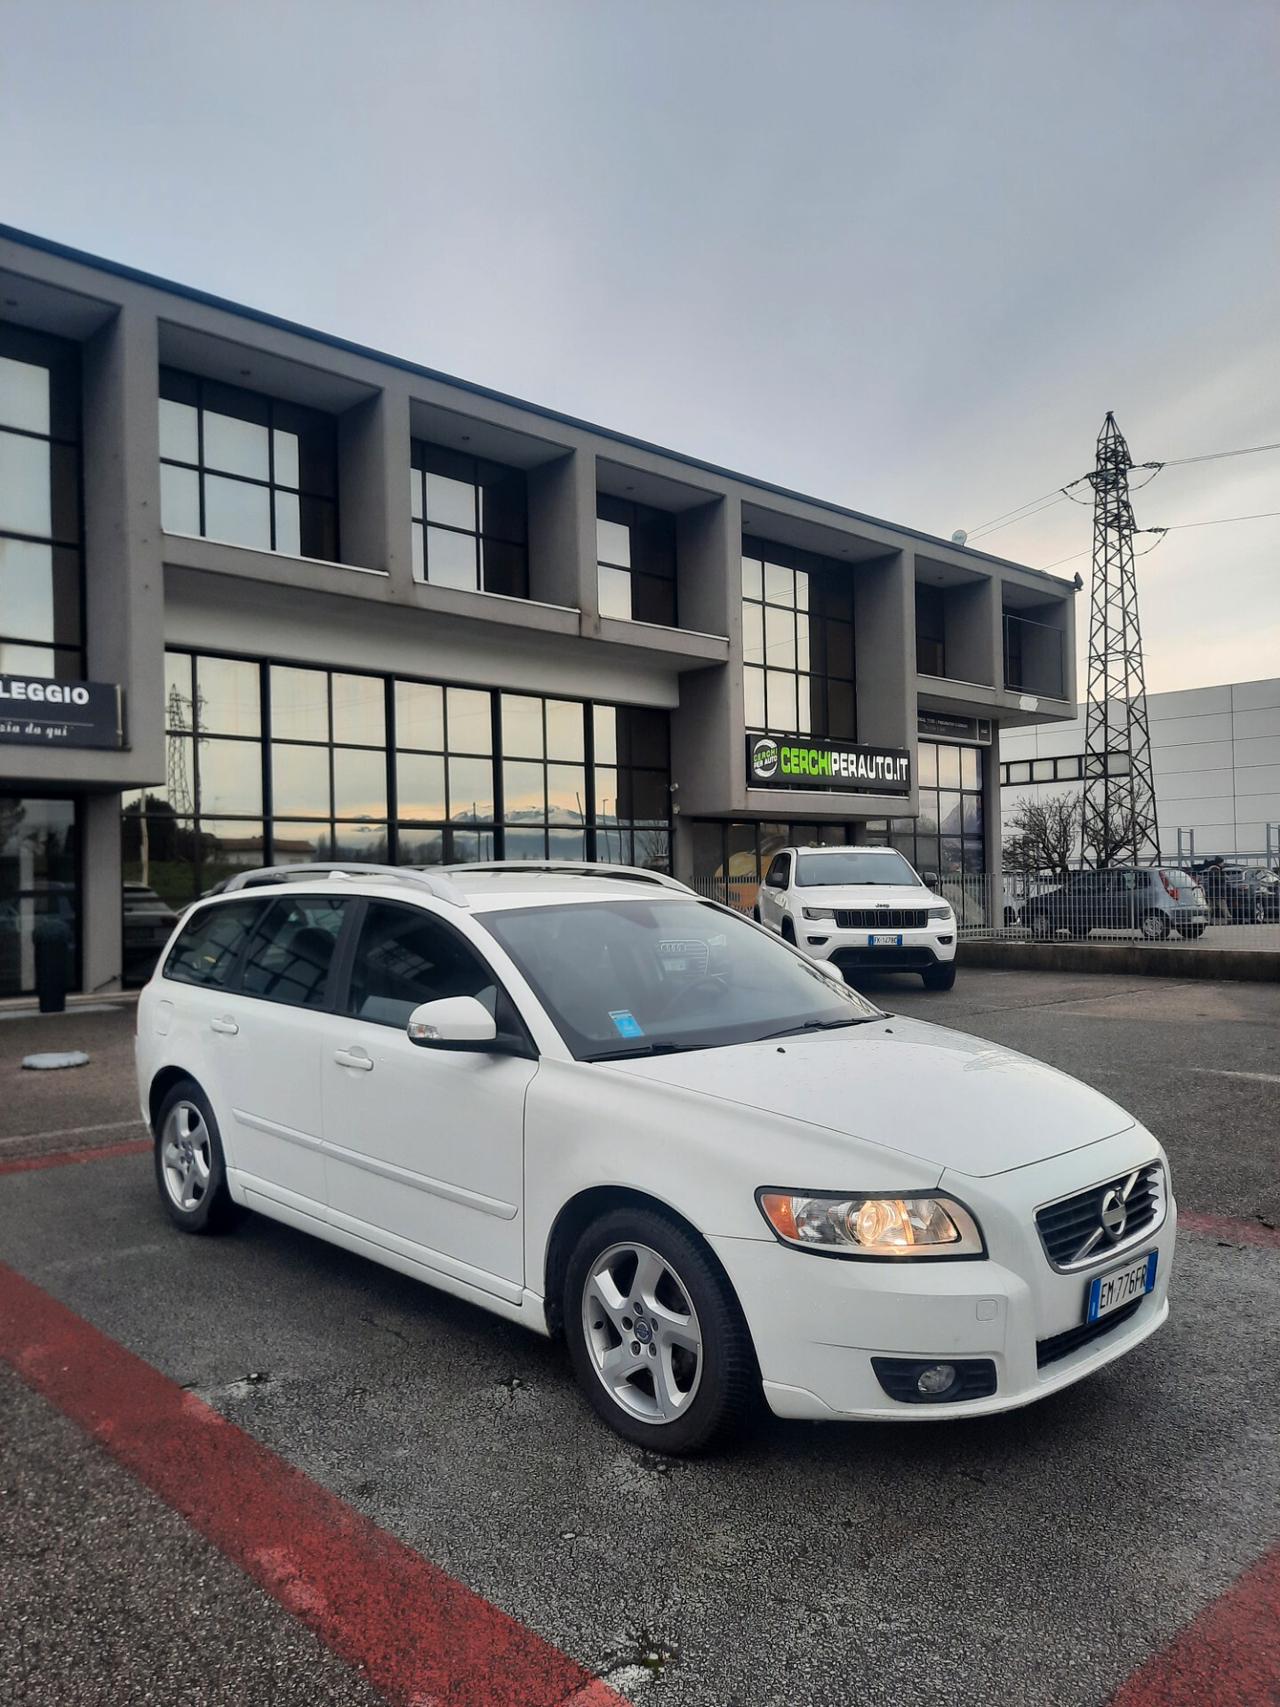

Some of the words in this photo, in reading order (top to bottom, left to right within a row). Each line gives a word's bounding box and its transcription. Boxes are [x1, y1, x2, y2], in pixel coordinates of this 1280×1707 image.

[0, 681, 90, 705] LEGGIO
[753, 747, 778, 762] CERCHI
[781, 747, 909, 781] CERCHIPERAUTO.IT
